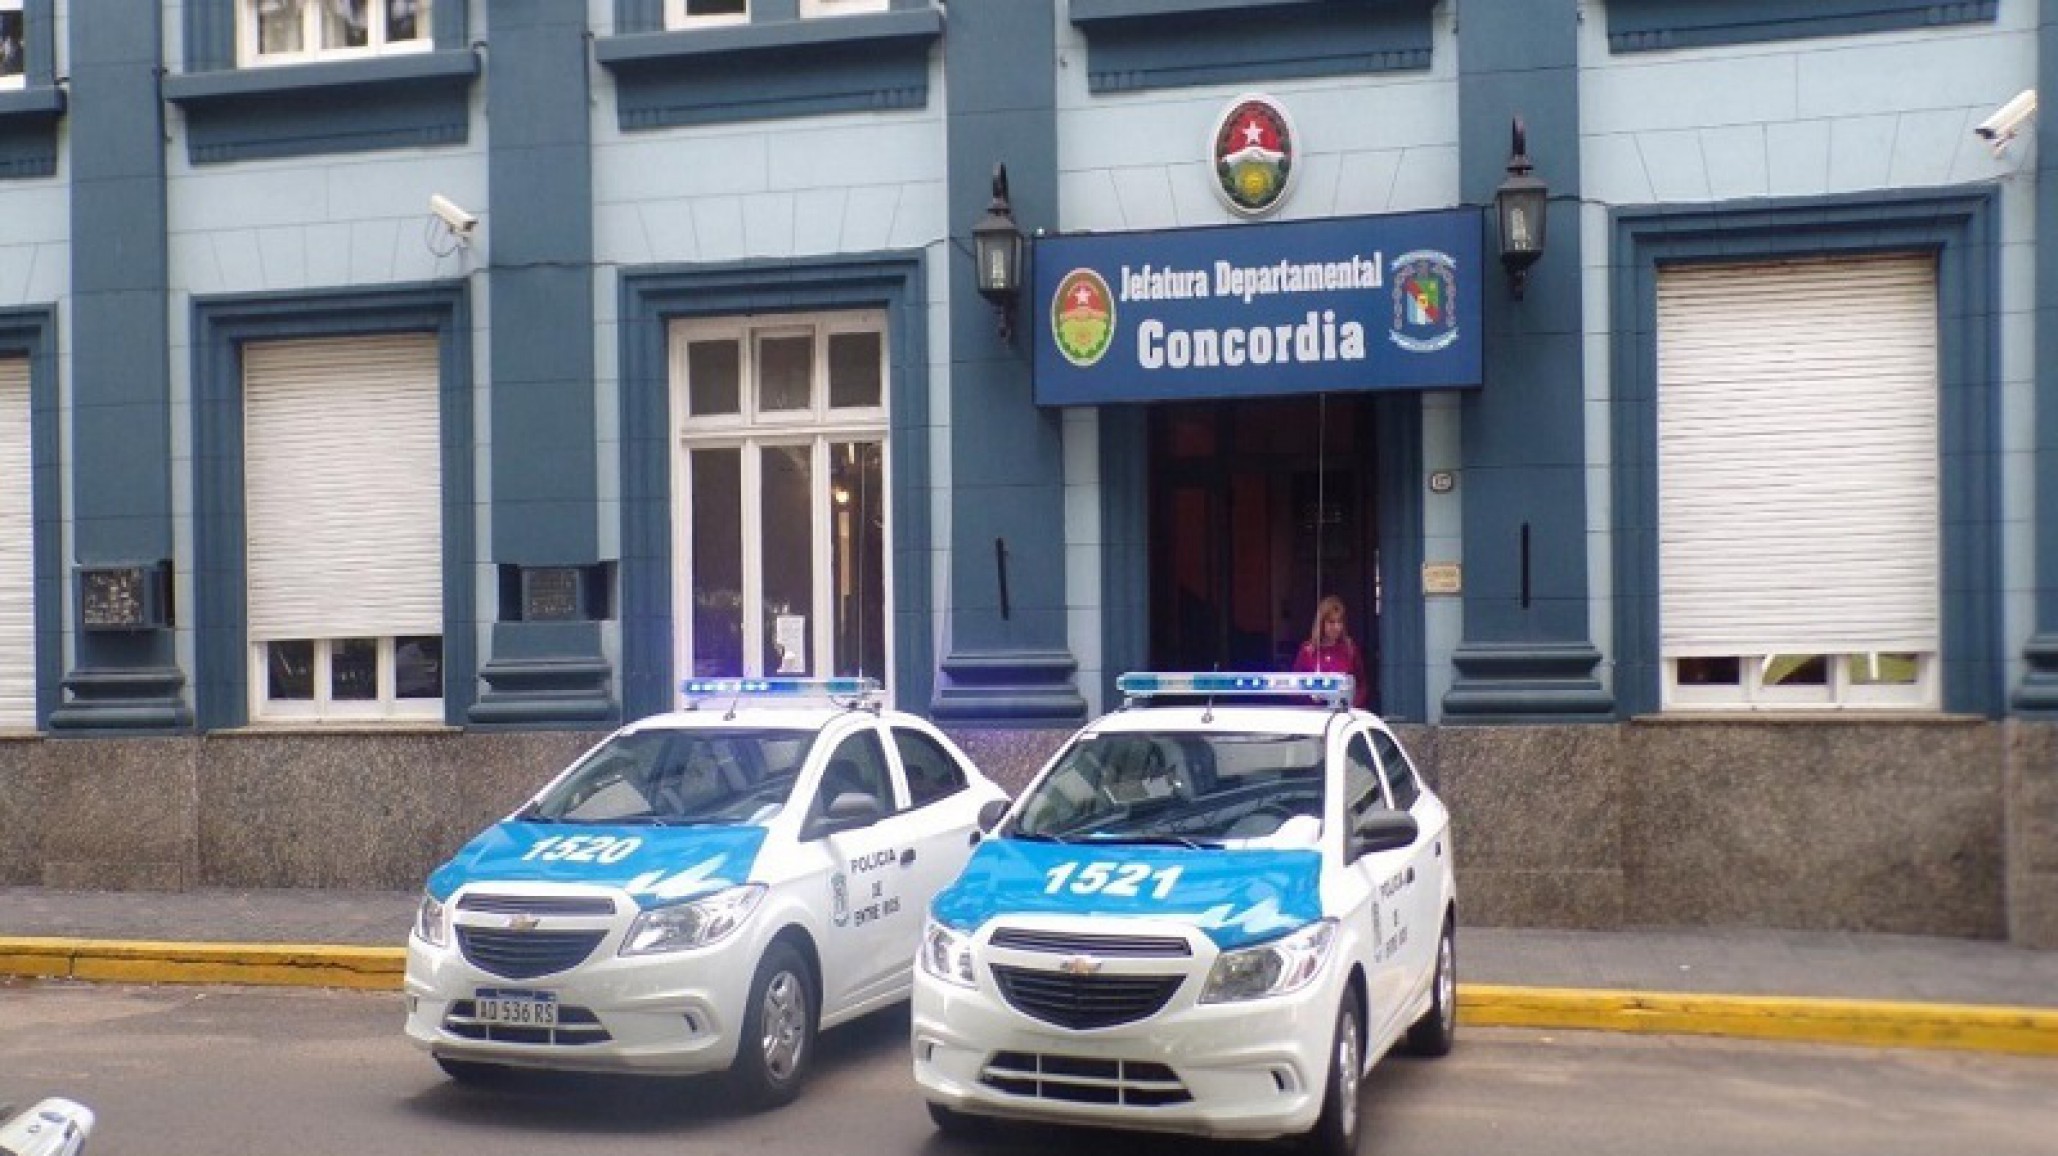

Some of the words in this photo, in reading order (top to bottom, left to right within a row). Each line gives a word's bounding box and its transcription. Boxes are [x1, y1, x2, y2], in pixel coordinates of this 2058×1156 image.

[1119, 265, 1209, 301] Jefatura
[1214, 251, 1383, 304] Departamental
[1137, 309, 1366, 369] Concordia
[520, 834, 642, 865] 1520
[850, 848, 897, 873] POLICIA
[1044, 860, 1185, 900] 1521
[503, 1000, 531, 1023] 536
[534, 1002, 554, 1023] RS
